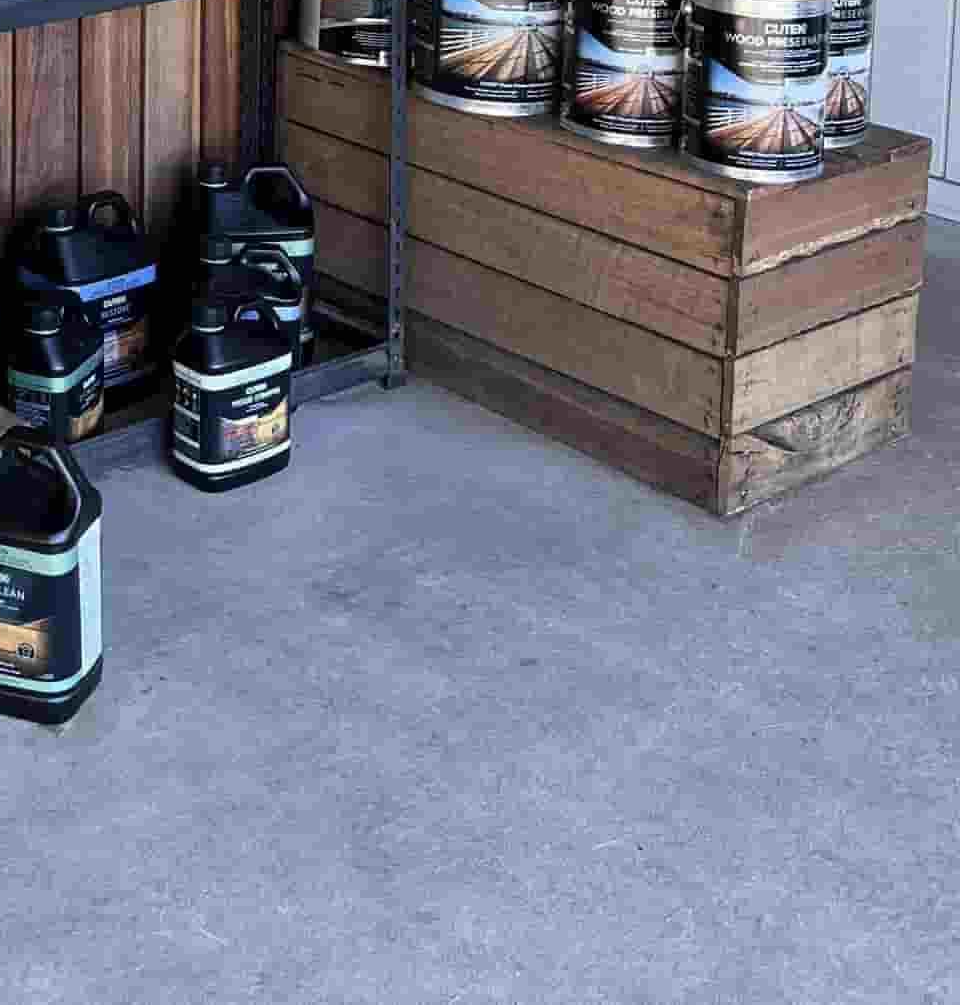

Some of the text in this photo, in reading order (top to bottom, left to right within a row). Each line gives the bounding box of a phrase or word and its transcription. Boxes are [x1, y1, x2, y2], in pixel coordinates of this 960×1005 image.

[592, 2, 626, 17] WOOD
[765, 22, 808, 36] CUTEK
[725, 33, 765, 47] WOOD
